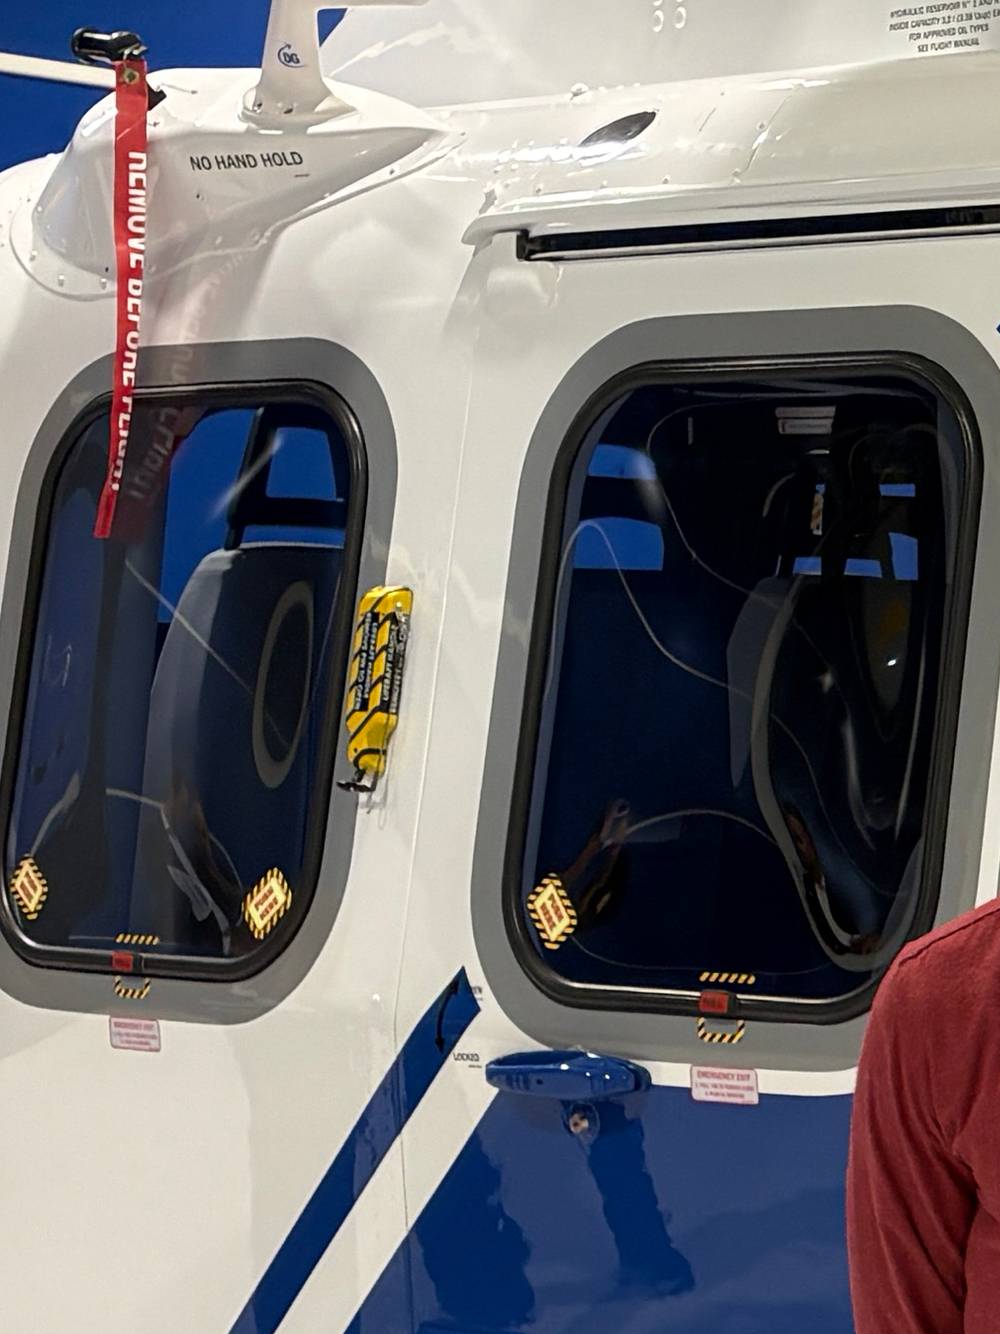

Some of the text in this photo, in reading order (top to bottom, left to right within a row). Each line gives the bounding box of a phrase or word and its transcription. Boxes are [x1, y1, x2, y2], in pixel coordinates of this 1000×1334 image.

[190, 151, 304, 171] NO HAND HOLD
[111, 396, 133, 491] FLIGH
